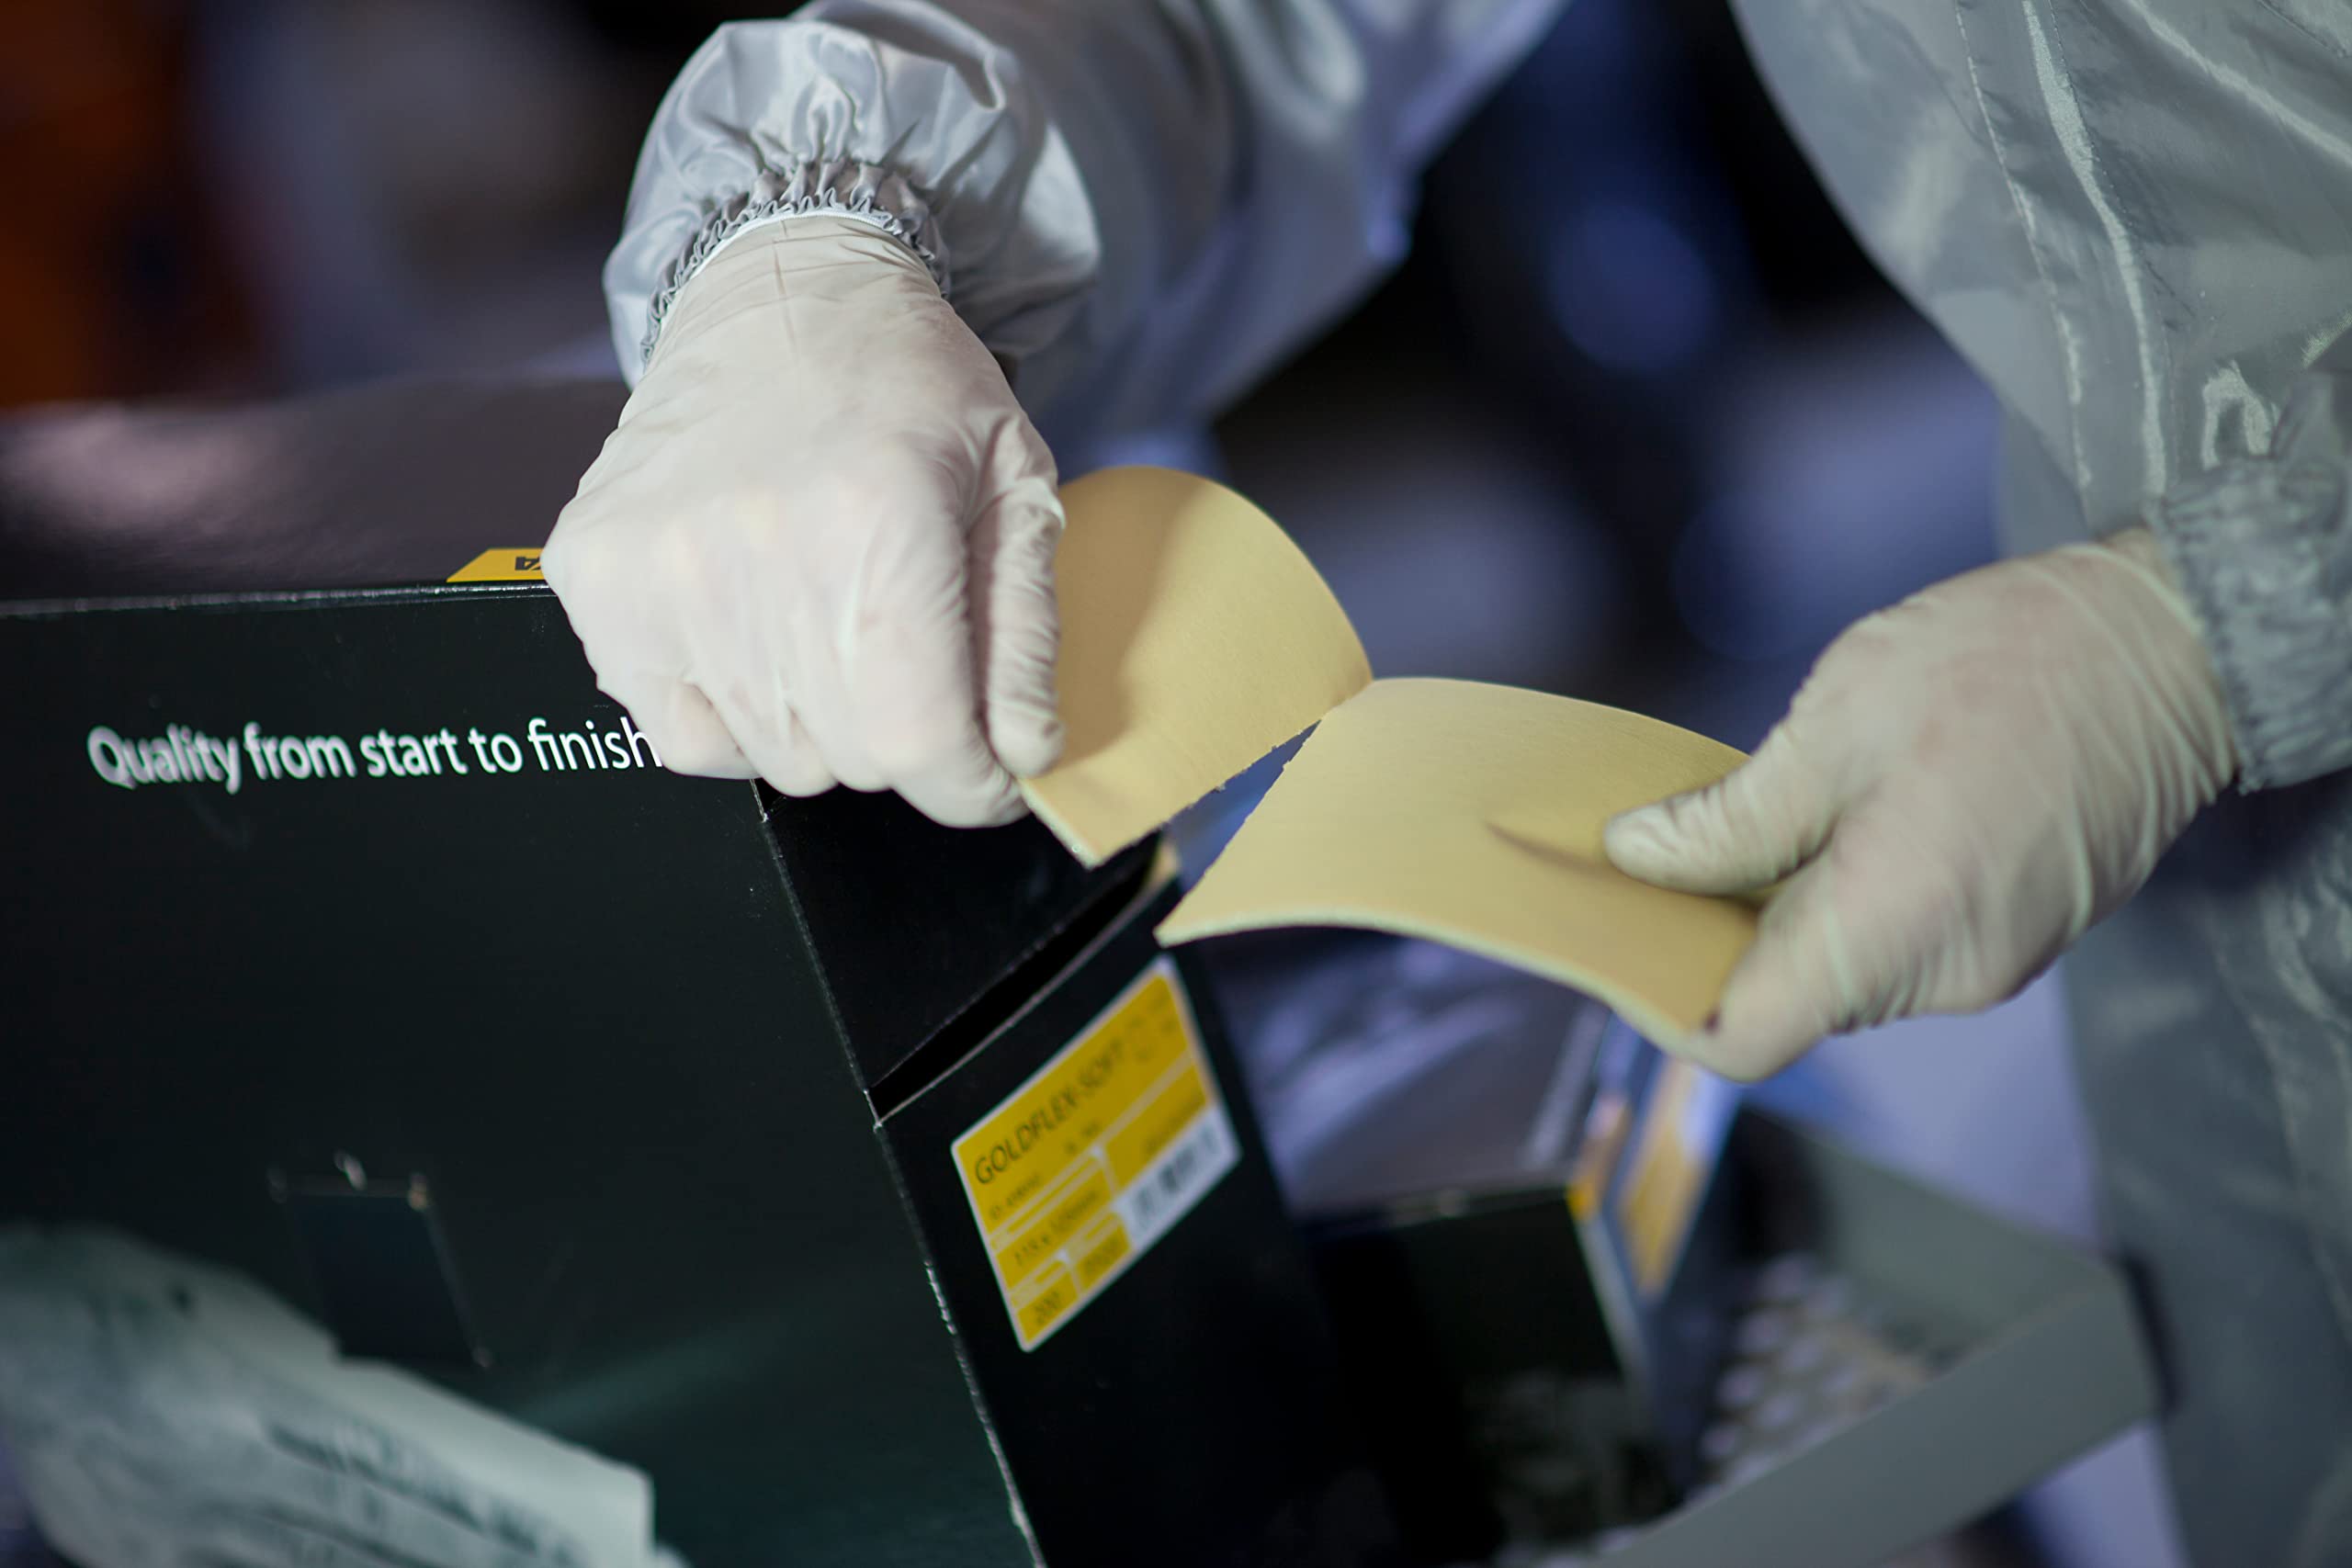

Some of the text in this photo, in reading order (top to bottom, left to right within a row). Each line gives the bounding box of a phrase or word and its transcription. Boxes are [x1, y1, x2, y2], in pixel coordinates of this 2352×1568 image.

[87, 716, 663, 795] Quality from start to finish
